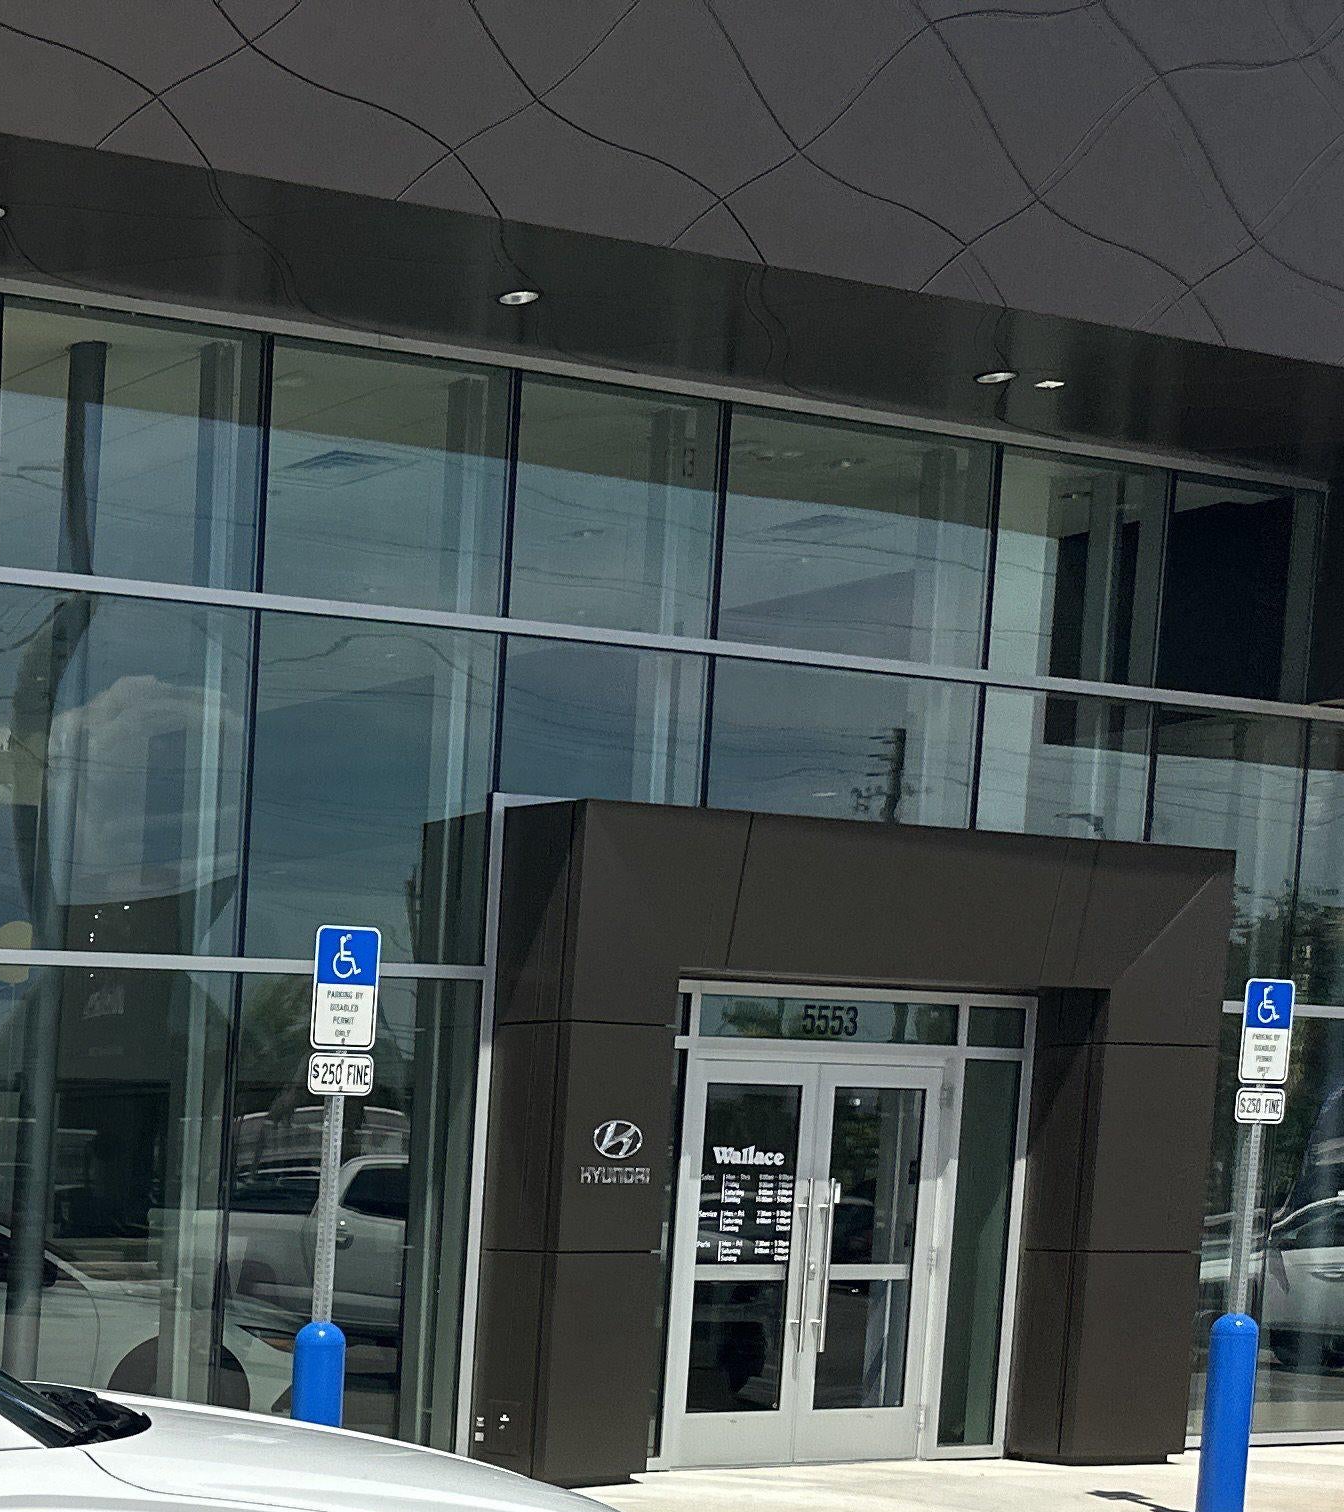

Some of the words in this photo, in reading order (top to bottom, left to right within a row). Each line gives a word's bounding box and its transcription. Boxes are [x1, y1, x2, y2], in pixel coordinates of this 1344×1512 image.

[802, 1004, 859, 1036] 5553
[312, 1063, 343, 1085] $250
[346, 1064, 370, 1086] FINE
[1264, 1099, 1282, 1114] FINE
[713, 1145, 785, 1166] Wallace
[580, 1166, 651, 1184] HYUNDAI
